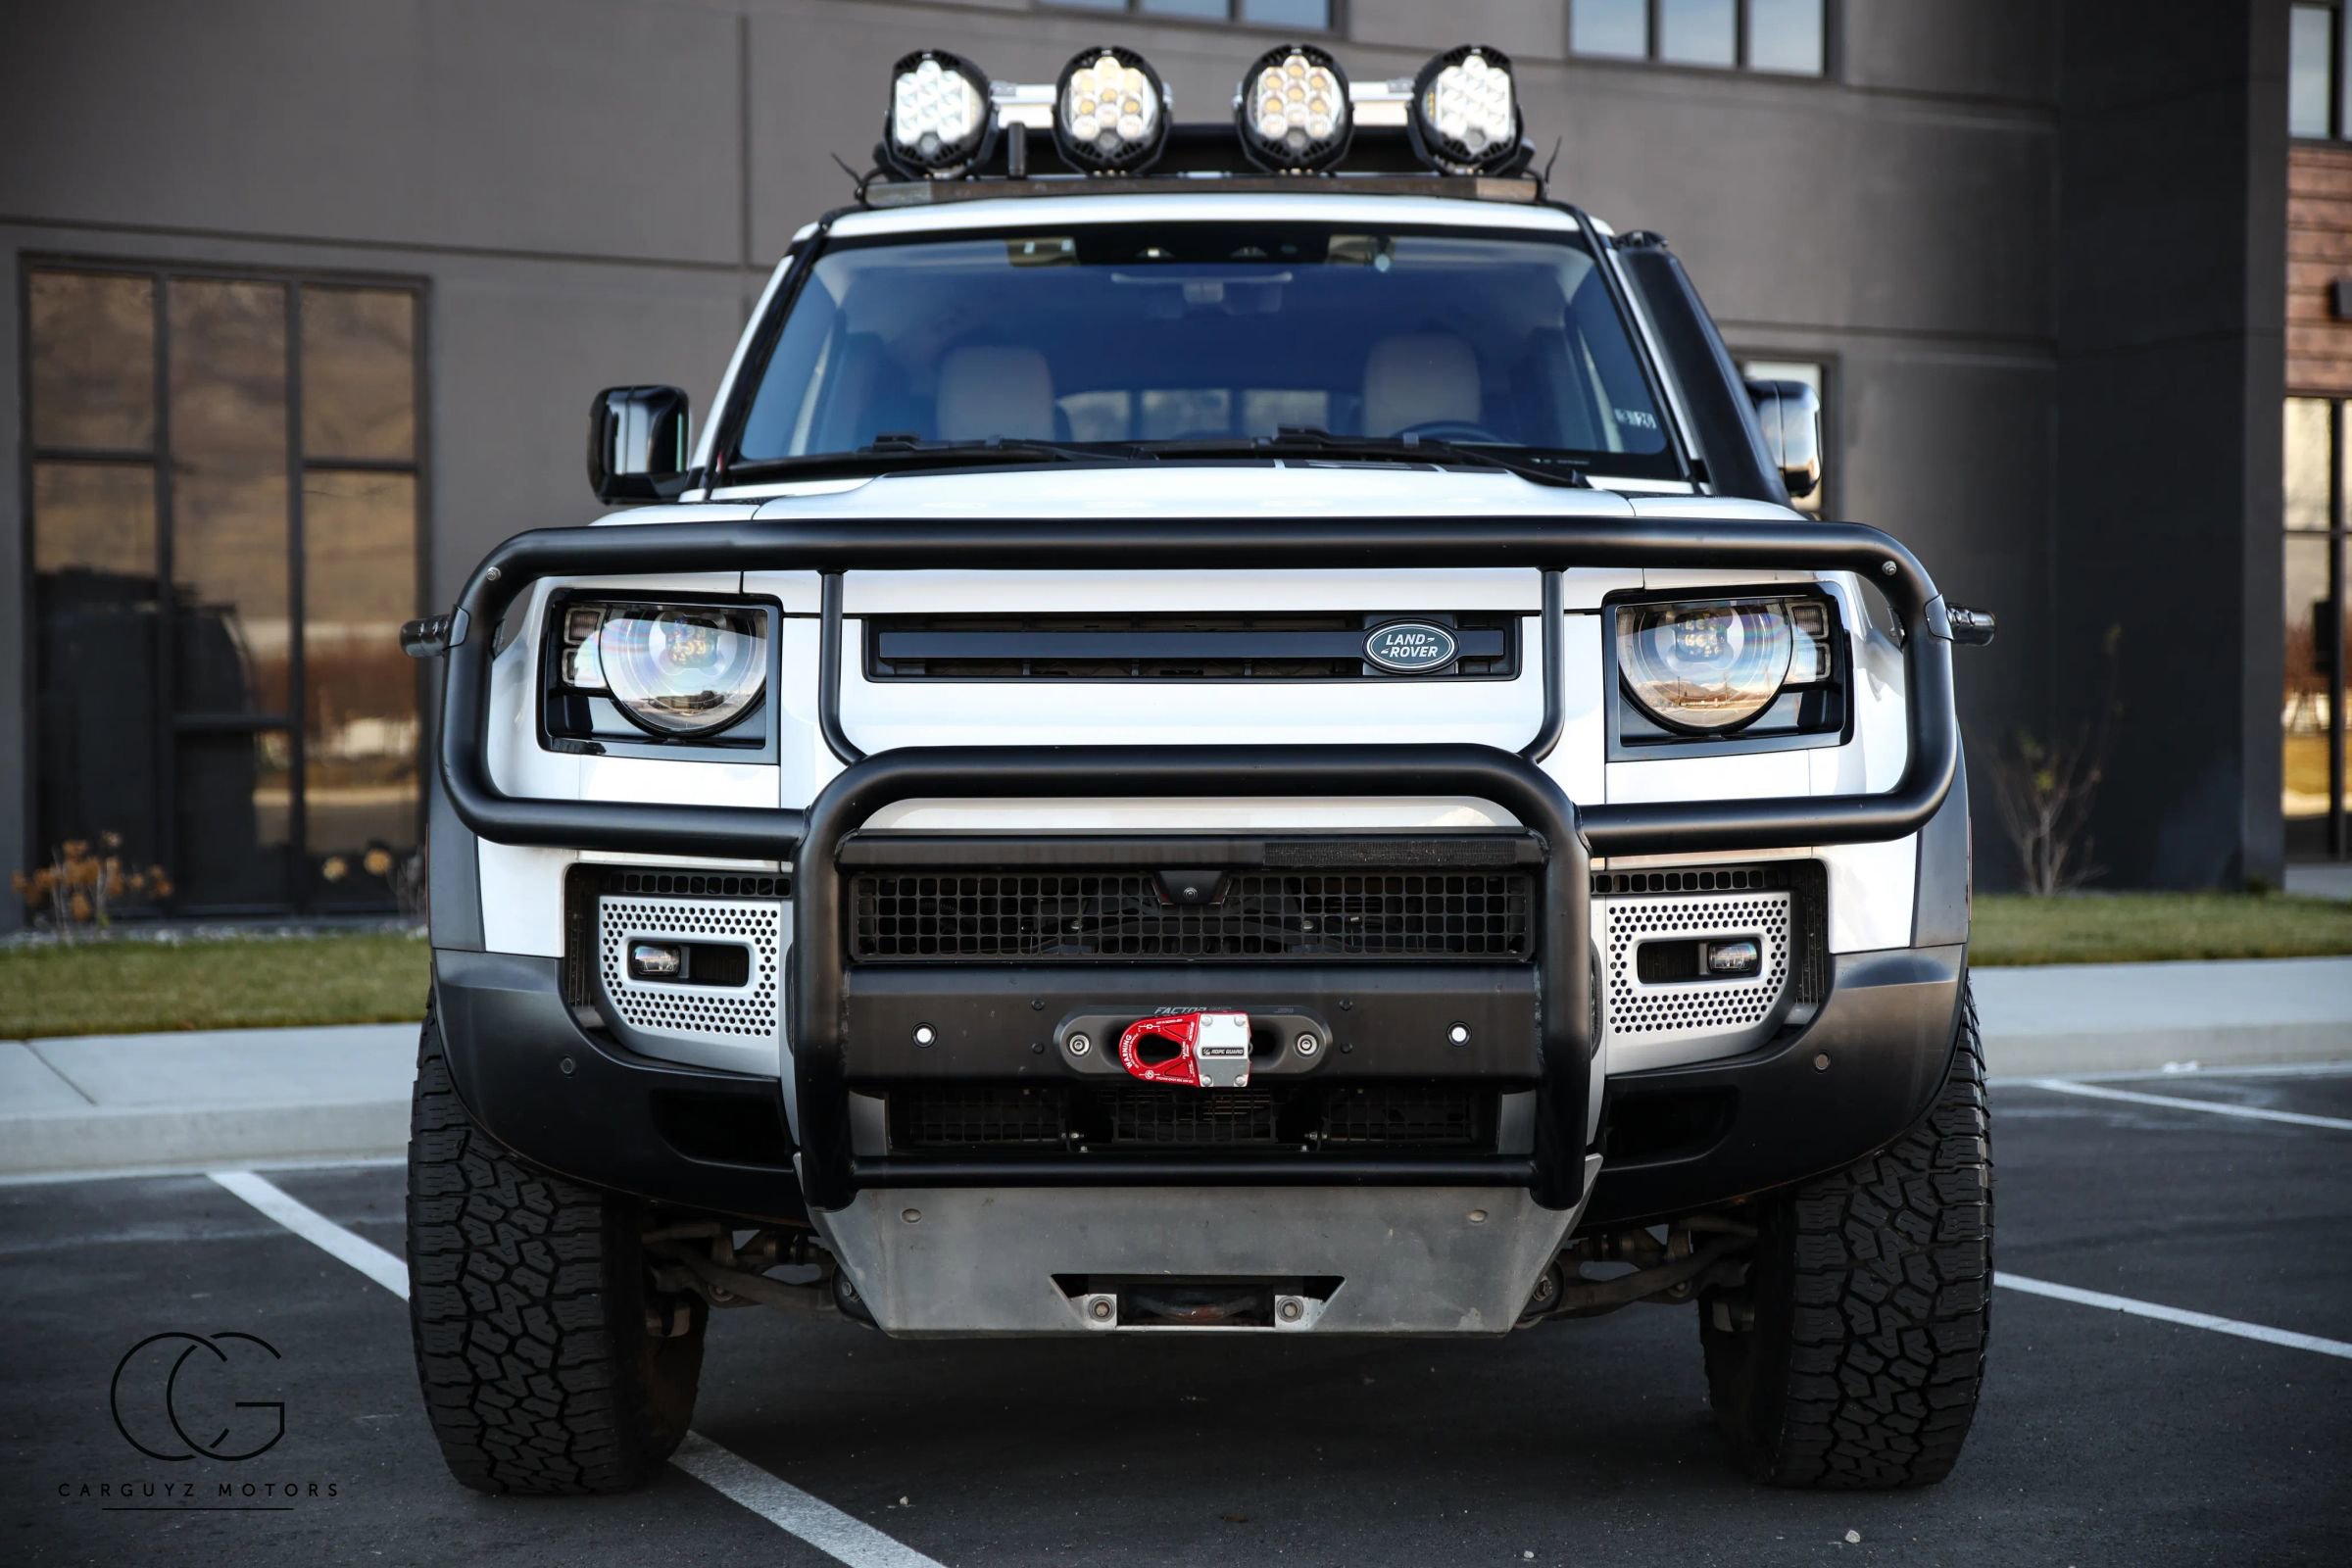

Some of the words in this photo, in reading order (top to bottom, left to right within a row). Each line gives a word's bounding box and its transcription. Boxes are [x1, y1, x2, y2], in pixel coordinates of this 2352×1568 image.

[1386, 634, 1426, 646] LAND
[1390, 647, 1439, 658] ROVER
[1121, 1034, 1133, 1069] WARNING
